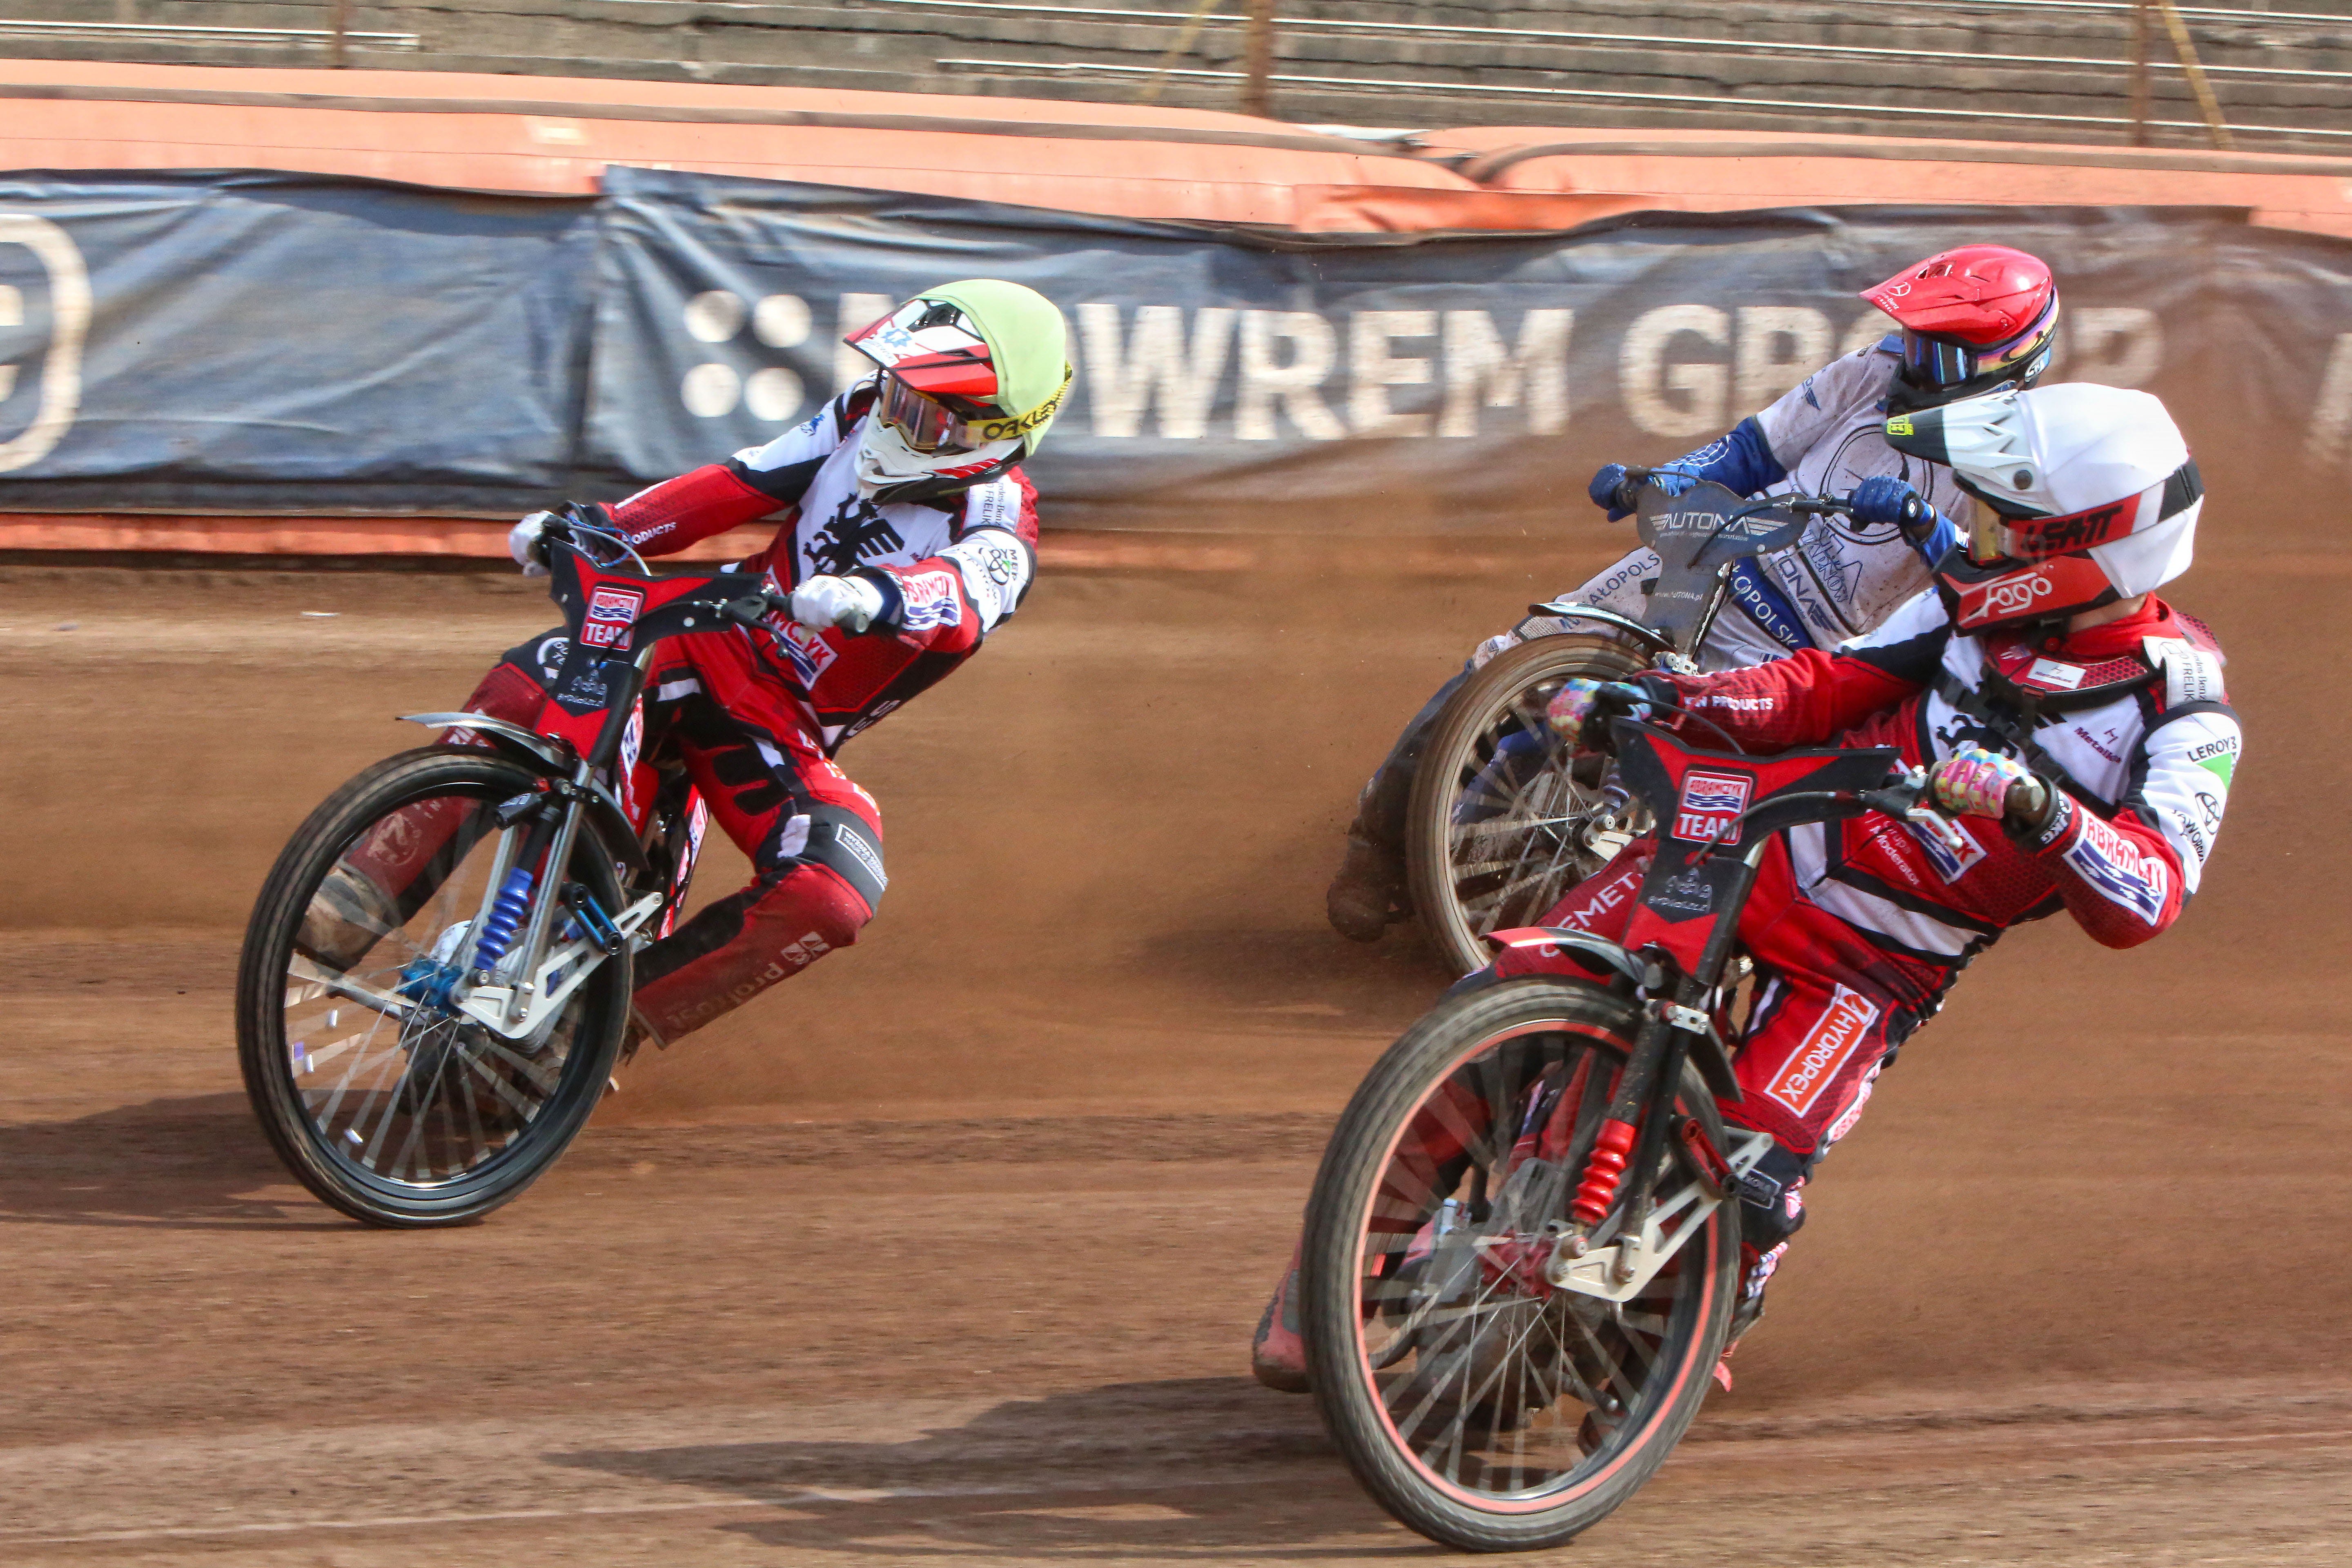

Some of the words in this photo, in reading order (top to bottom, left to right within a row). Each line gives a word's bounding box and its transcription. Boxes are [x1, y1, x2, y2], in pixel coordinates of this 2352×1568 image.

[832, 292, 1575, 441] WREM
[1618, 303, 2166, 439] GRP
[586, 623, 632, 647] TEAM
[2187, 737, 2230, 762] LEROY
[1679, 813, 1738, 841] TEAM
[1779, 1011, 1858, 1102] HYDROPEX
